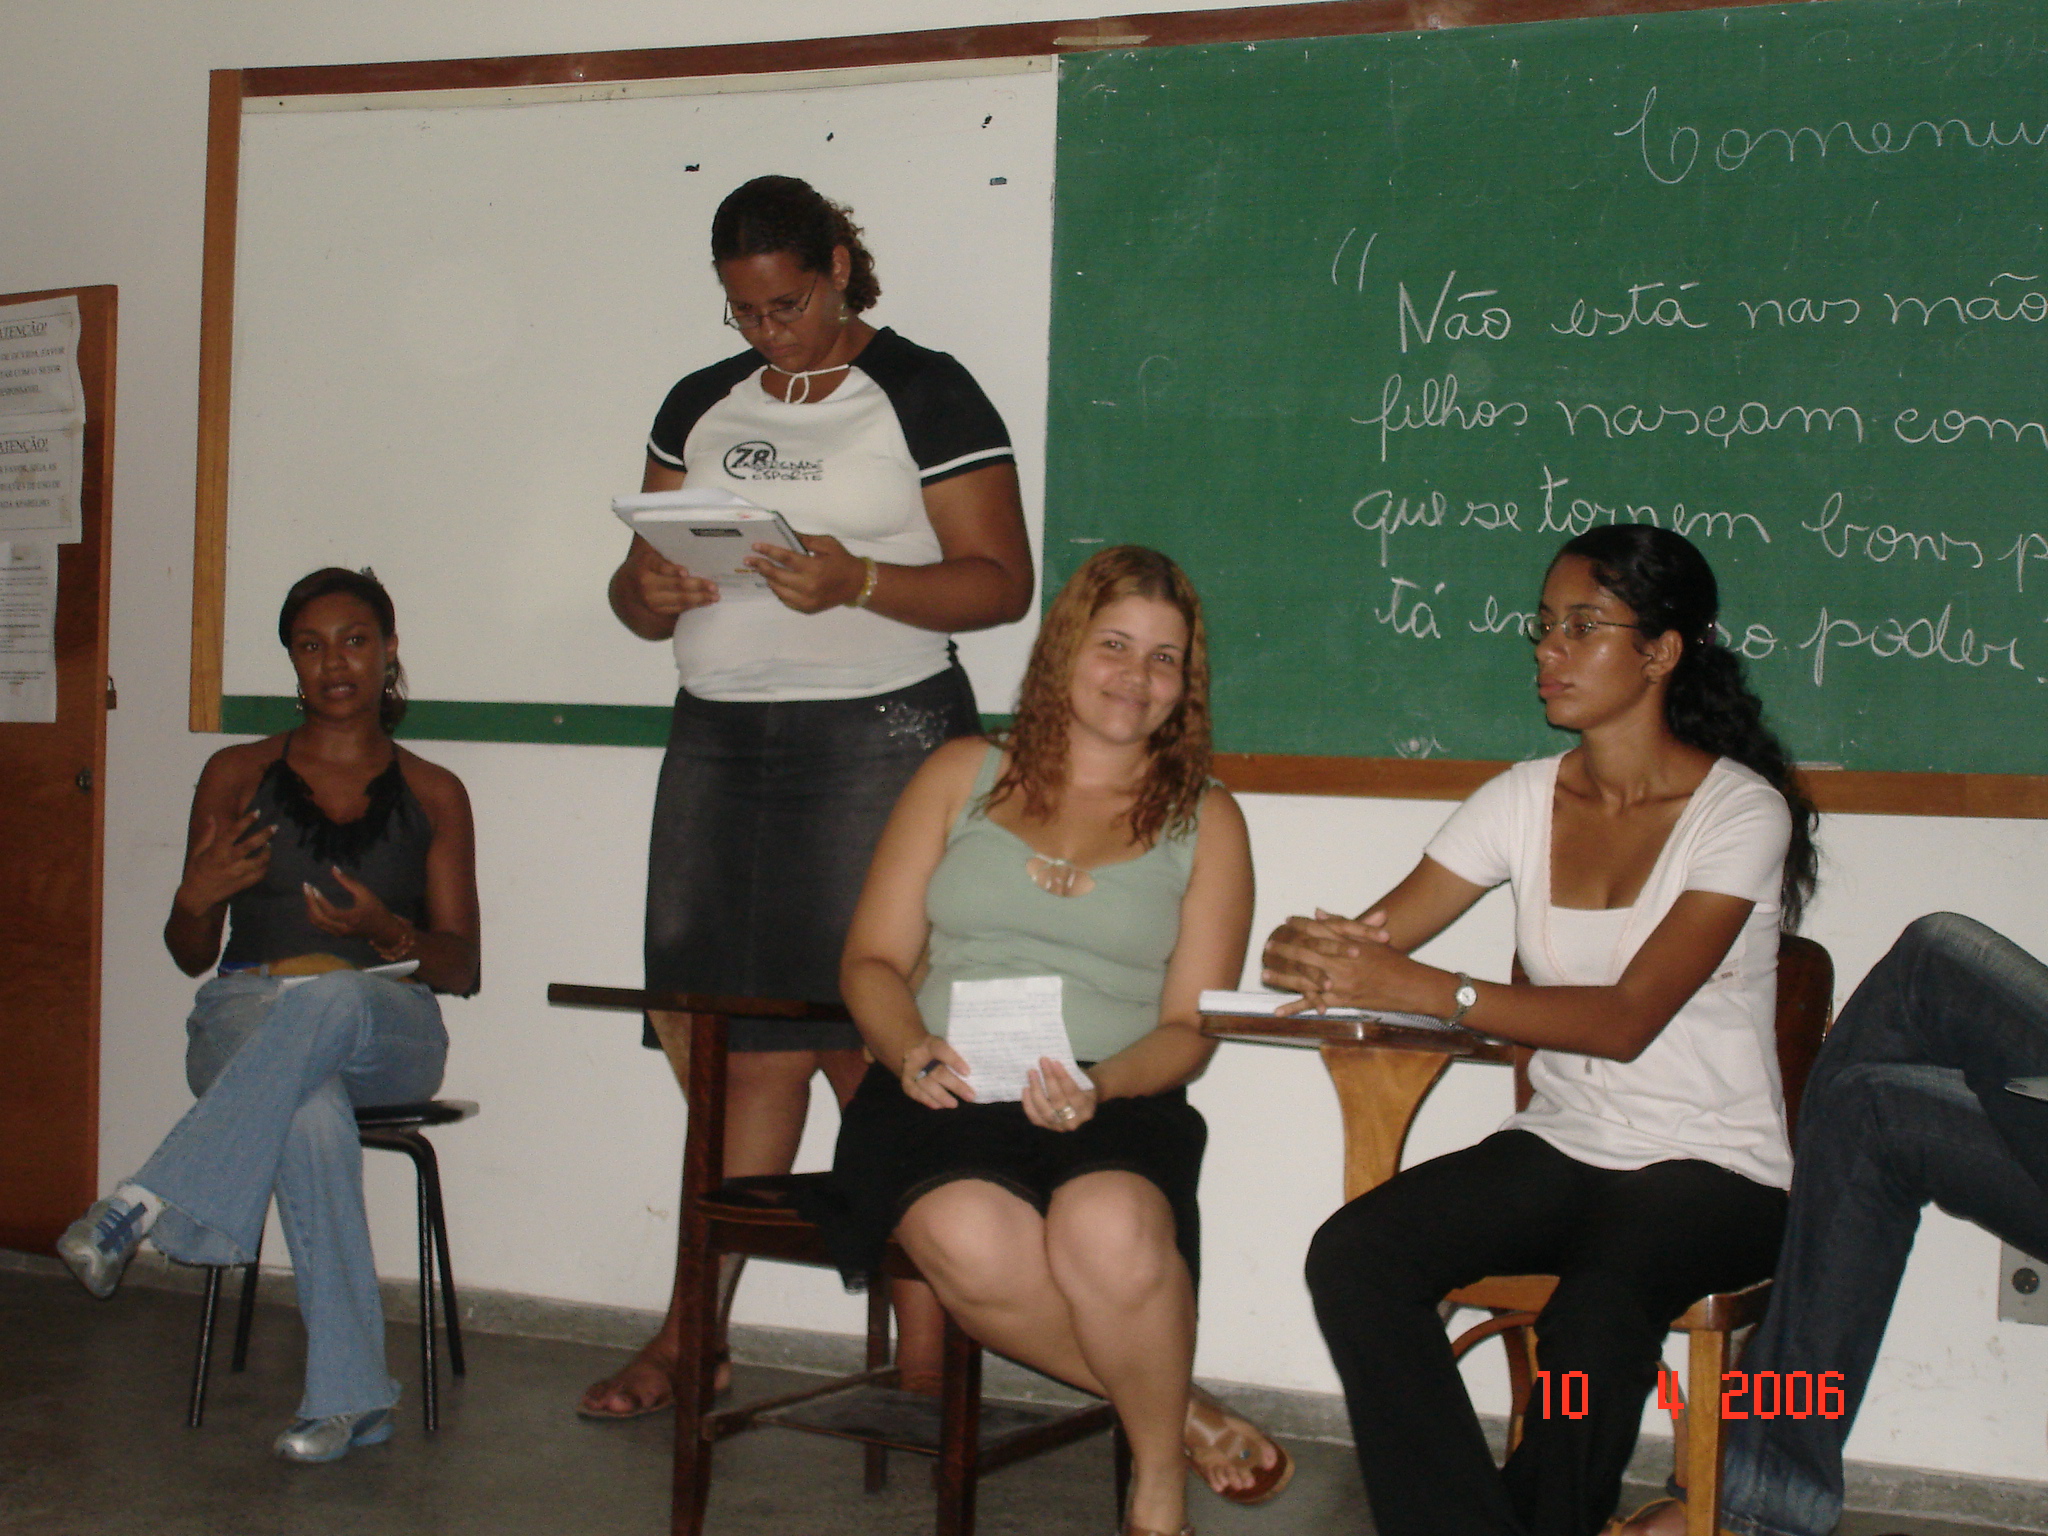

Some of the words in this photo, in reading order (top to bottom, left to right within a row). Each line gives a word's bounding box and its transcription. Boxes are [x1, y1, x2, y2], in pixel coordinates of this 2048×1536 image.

[1398, 269, 1511, 354] Não
[1550, 281, 1708, 338] está
[1738, 296, 1861, 330] nas
[1350, 373, 1529, 462] filhos
[1555, 400, 1864, 448] nasçam
[1894, 408, 2048, 450] com
[1352, 486, 1447, 568] que
[1460, 501, 1523, 531] se
[1802, 492, 1984, 569] bons
[1375, 576, 1445, 639] tá
